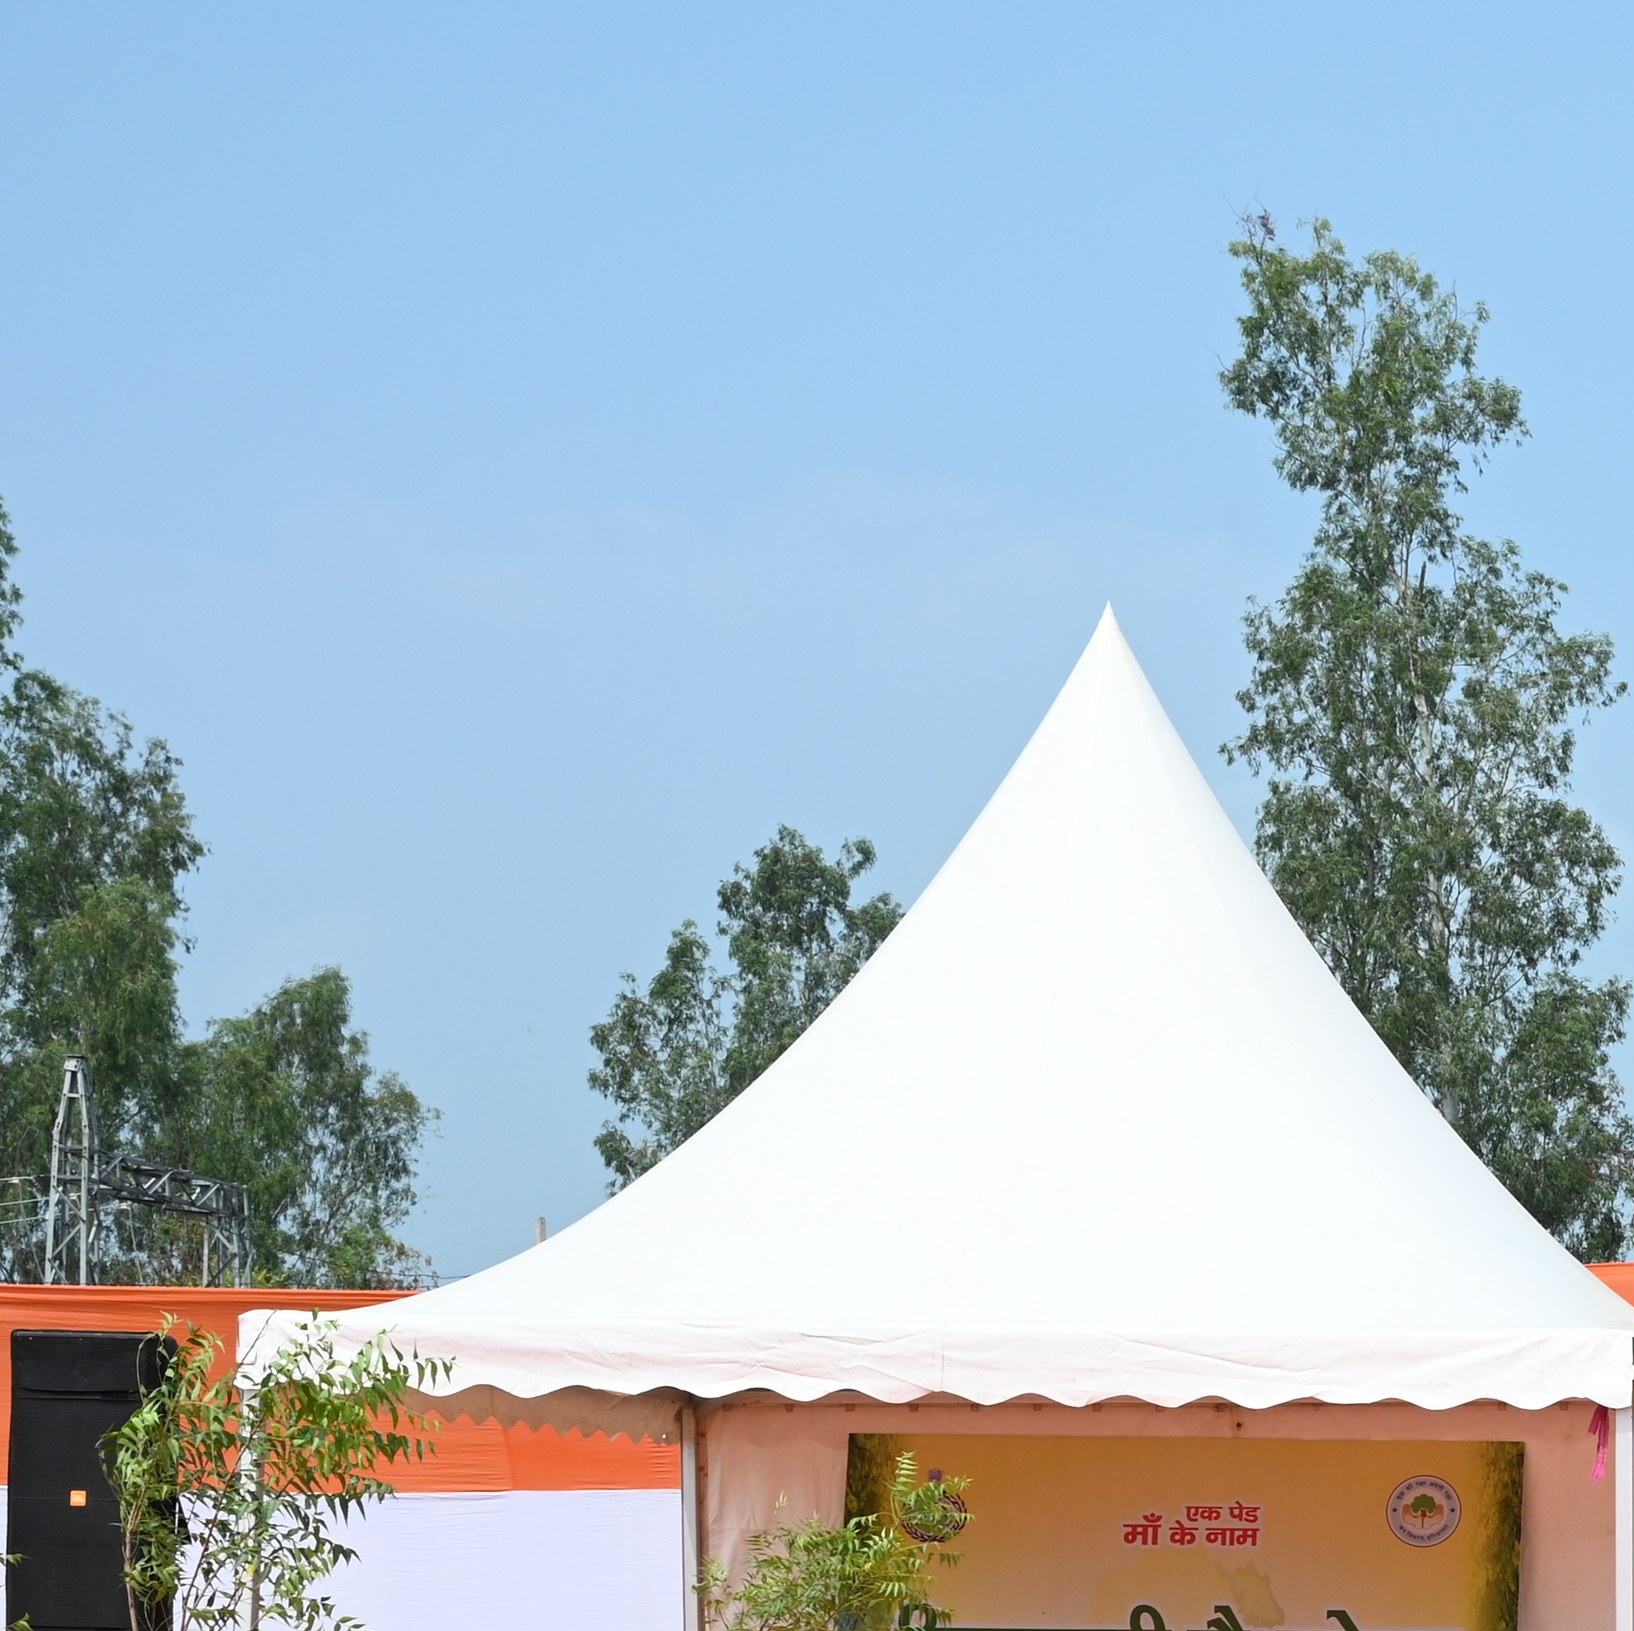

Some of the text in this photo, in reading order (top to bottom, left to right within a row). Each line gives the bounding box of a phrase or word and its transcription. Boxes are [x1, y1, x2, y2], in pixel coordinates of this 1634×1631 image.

[1185, 1505, 1222, 1522] एक
[1124, 1512, 1260, 1546] माँ के नाम
